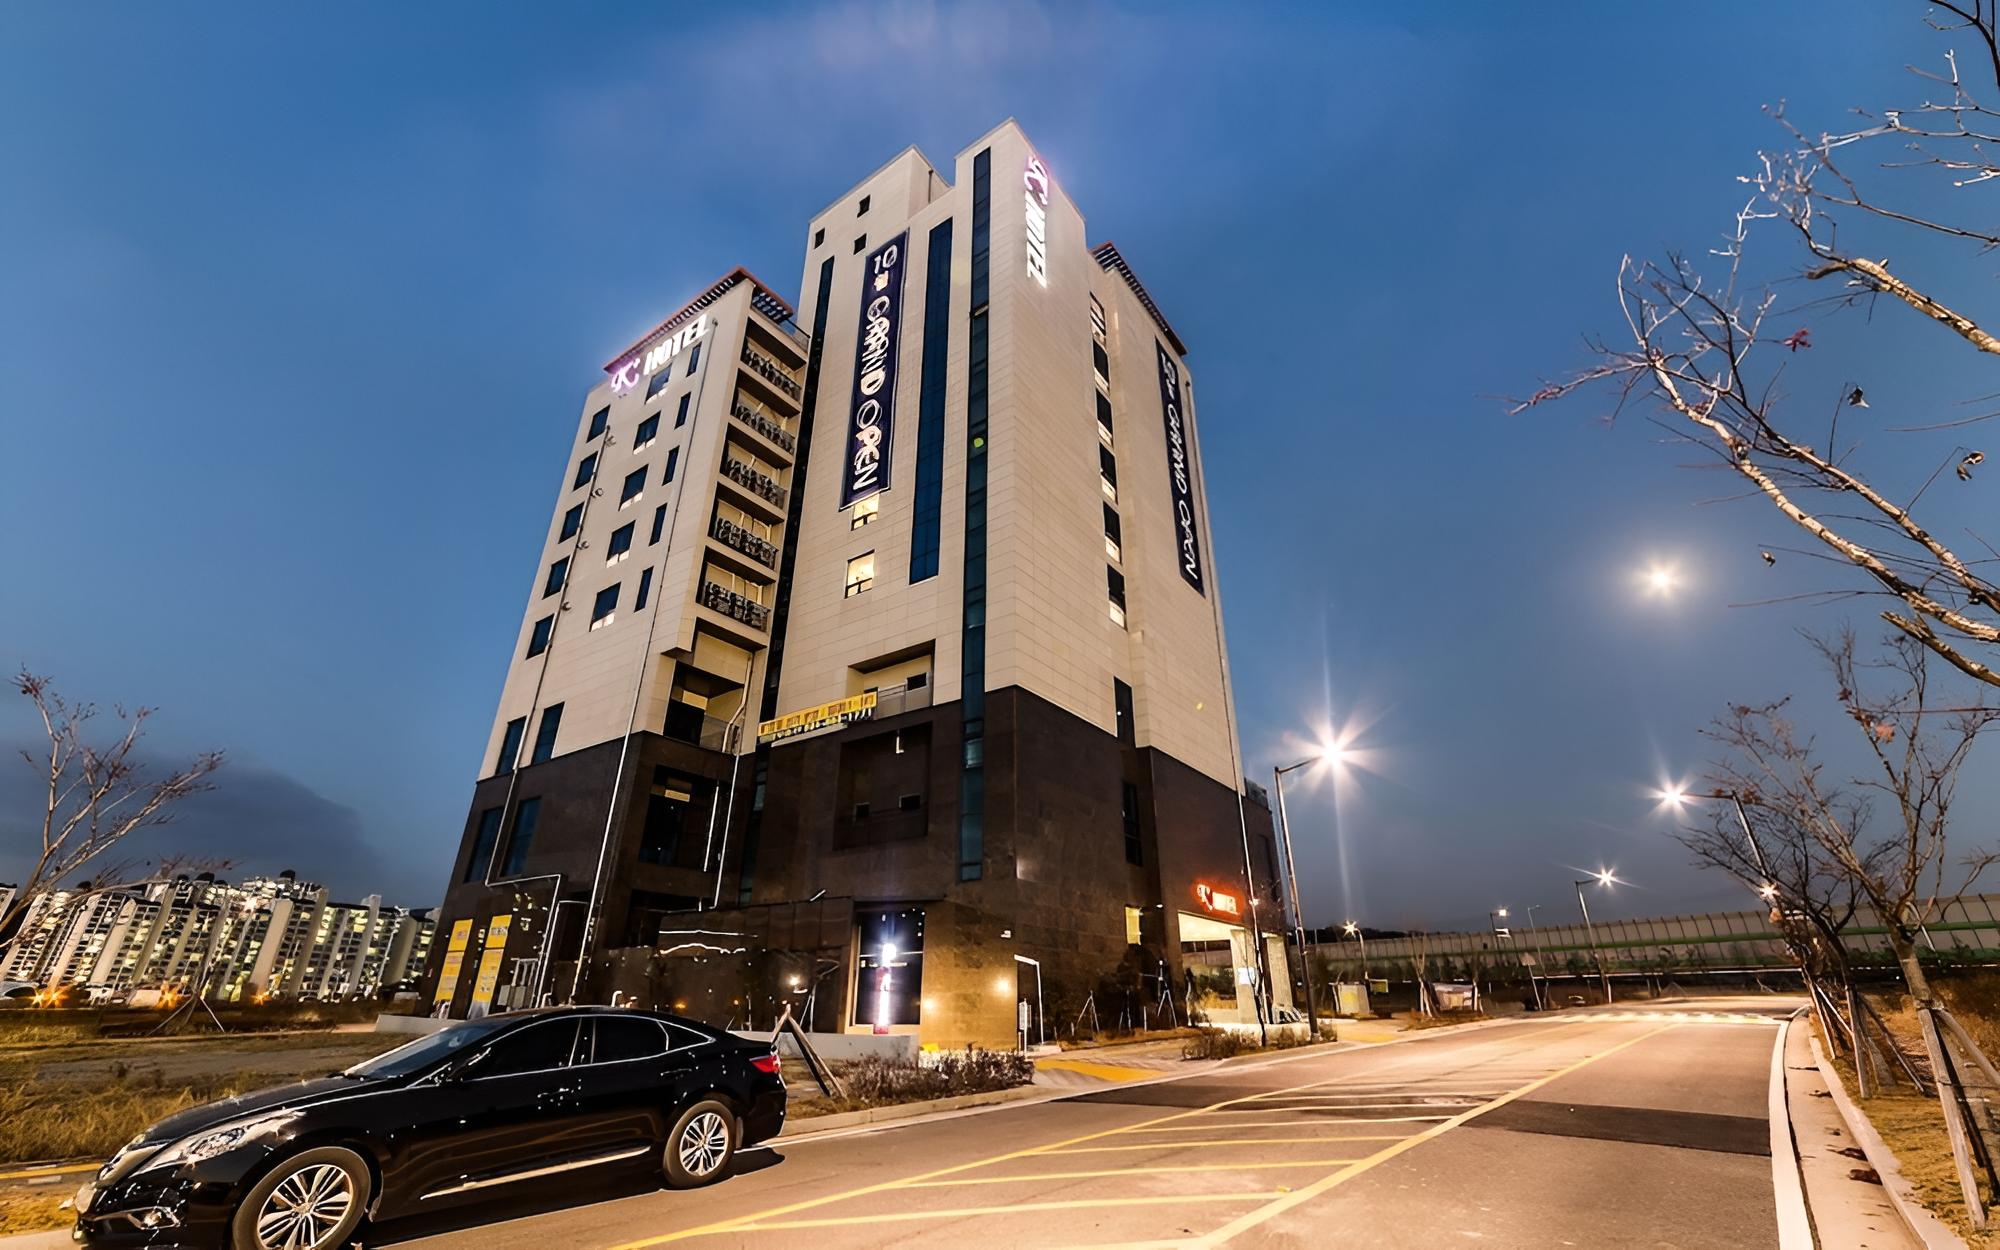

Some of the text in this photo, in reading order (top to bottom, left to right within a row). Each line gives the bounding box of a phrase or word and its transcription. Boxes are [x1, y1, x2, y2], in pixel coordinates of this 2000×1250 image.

[1025, 191, 1048, 289] HOTEL
[643, 313, 710, 376] HOTEL
[860, 295, 890, 396] GRAND
[852, 399, 883, 490] OPEN
[1167, 403, 1187, 494] GRAND
[1178, 499, 1198, 580] OPEN
